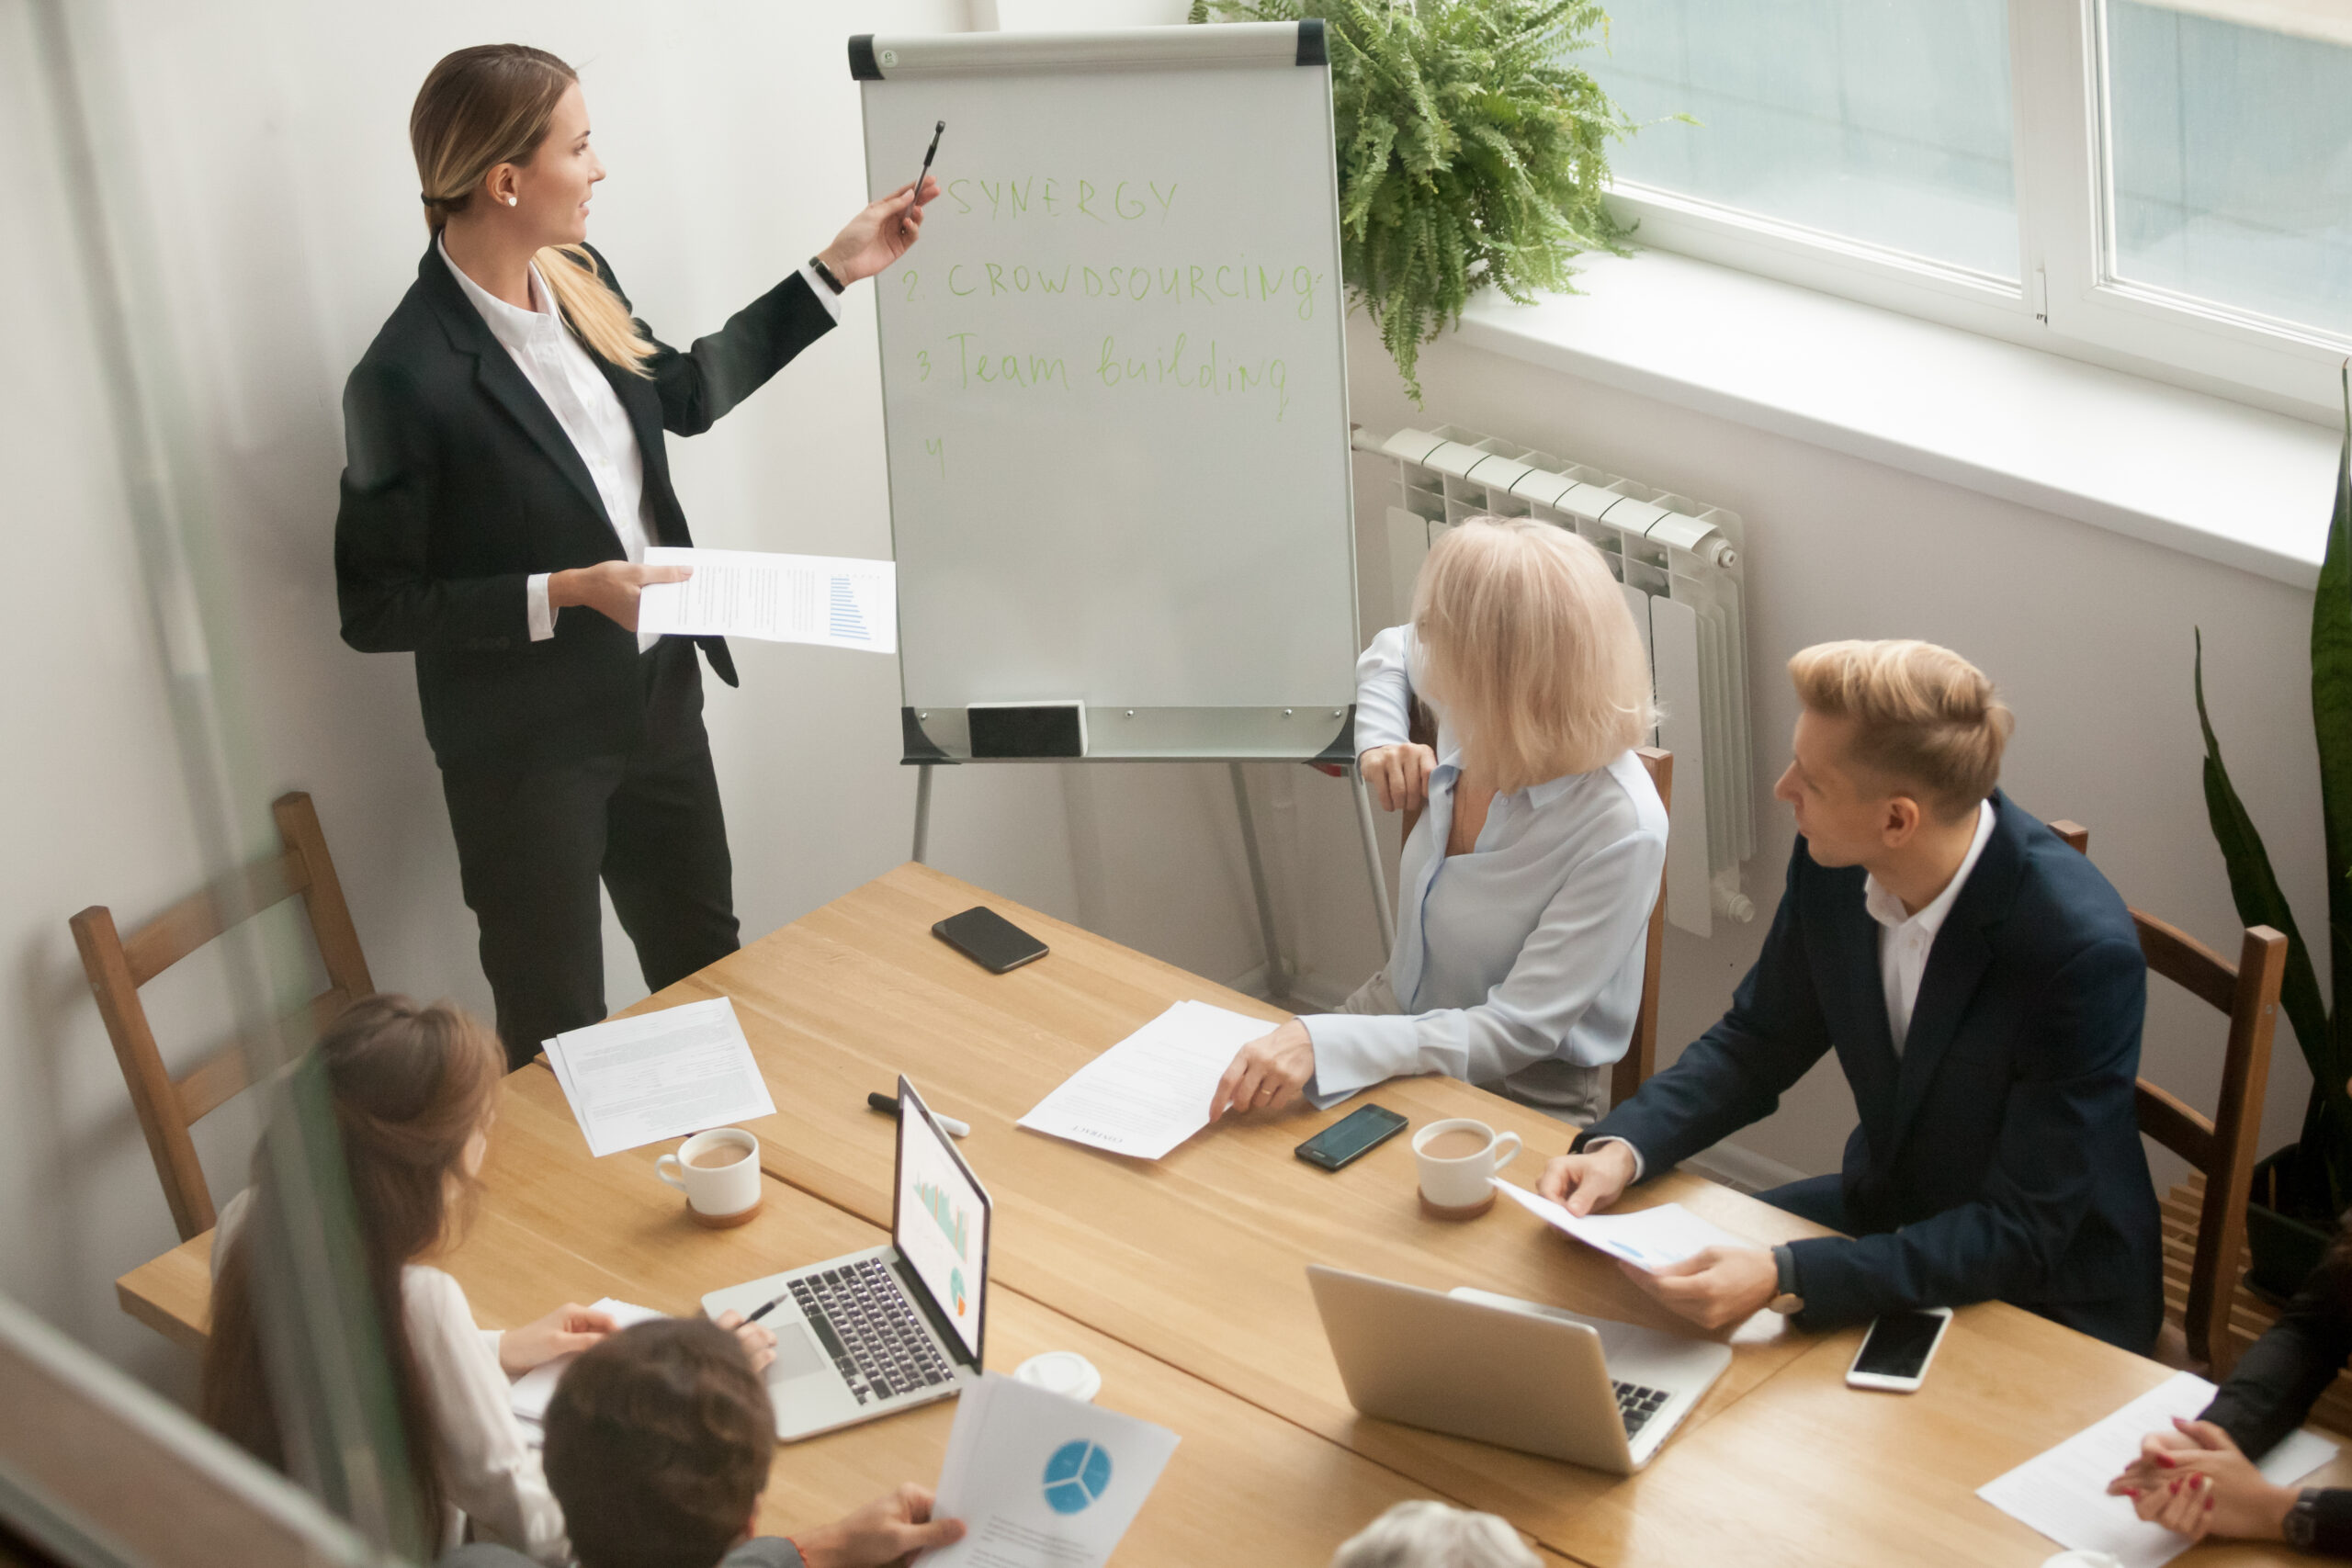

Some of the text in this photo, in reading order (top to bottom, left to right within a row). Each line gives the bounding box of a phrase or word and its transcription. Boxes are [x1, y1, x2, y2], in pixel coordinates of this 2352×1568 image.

[948, 177, 1177, 223] SYNERGY
[917, 350, 932, 382] 3
[947, 333, 1069, 389] Team
